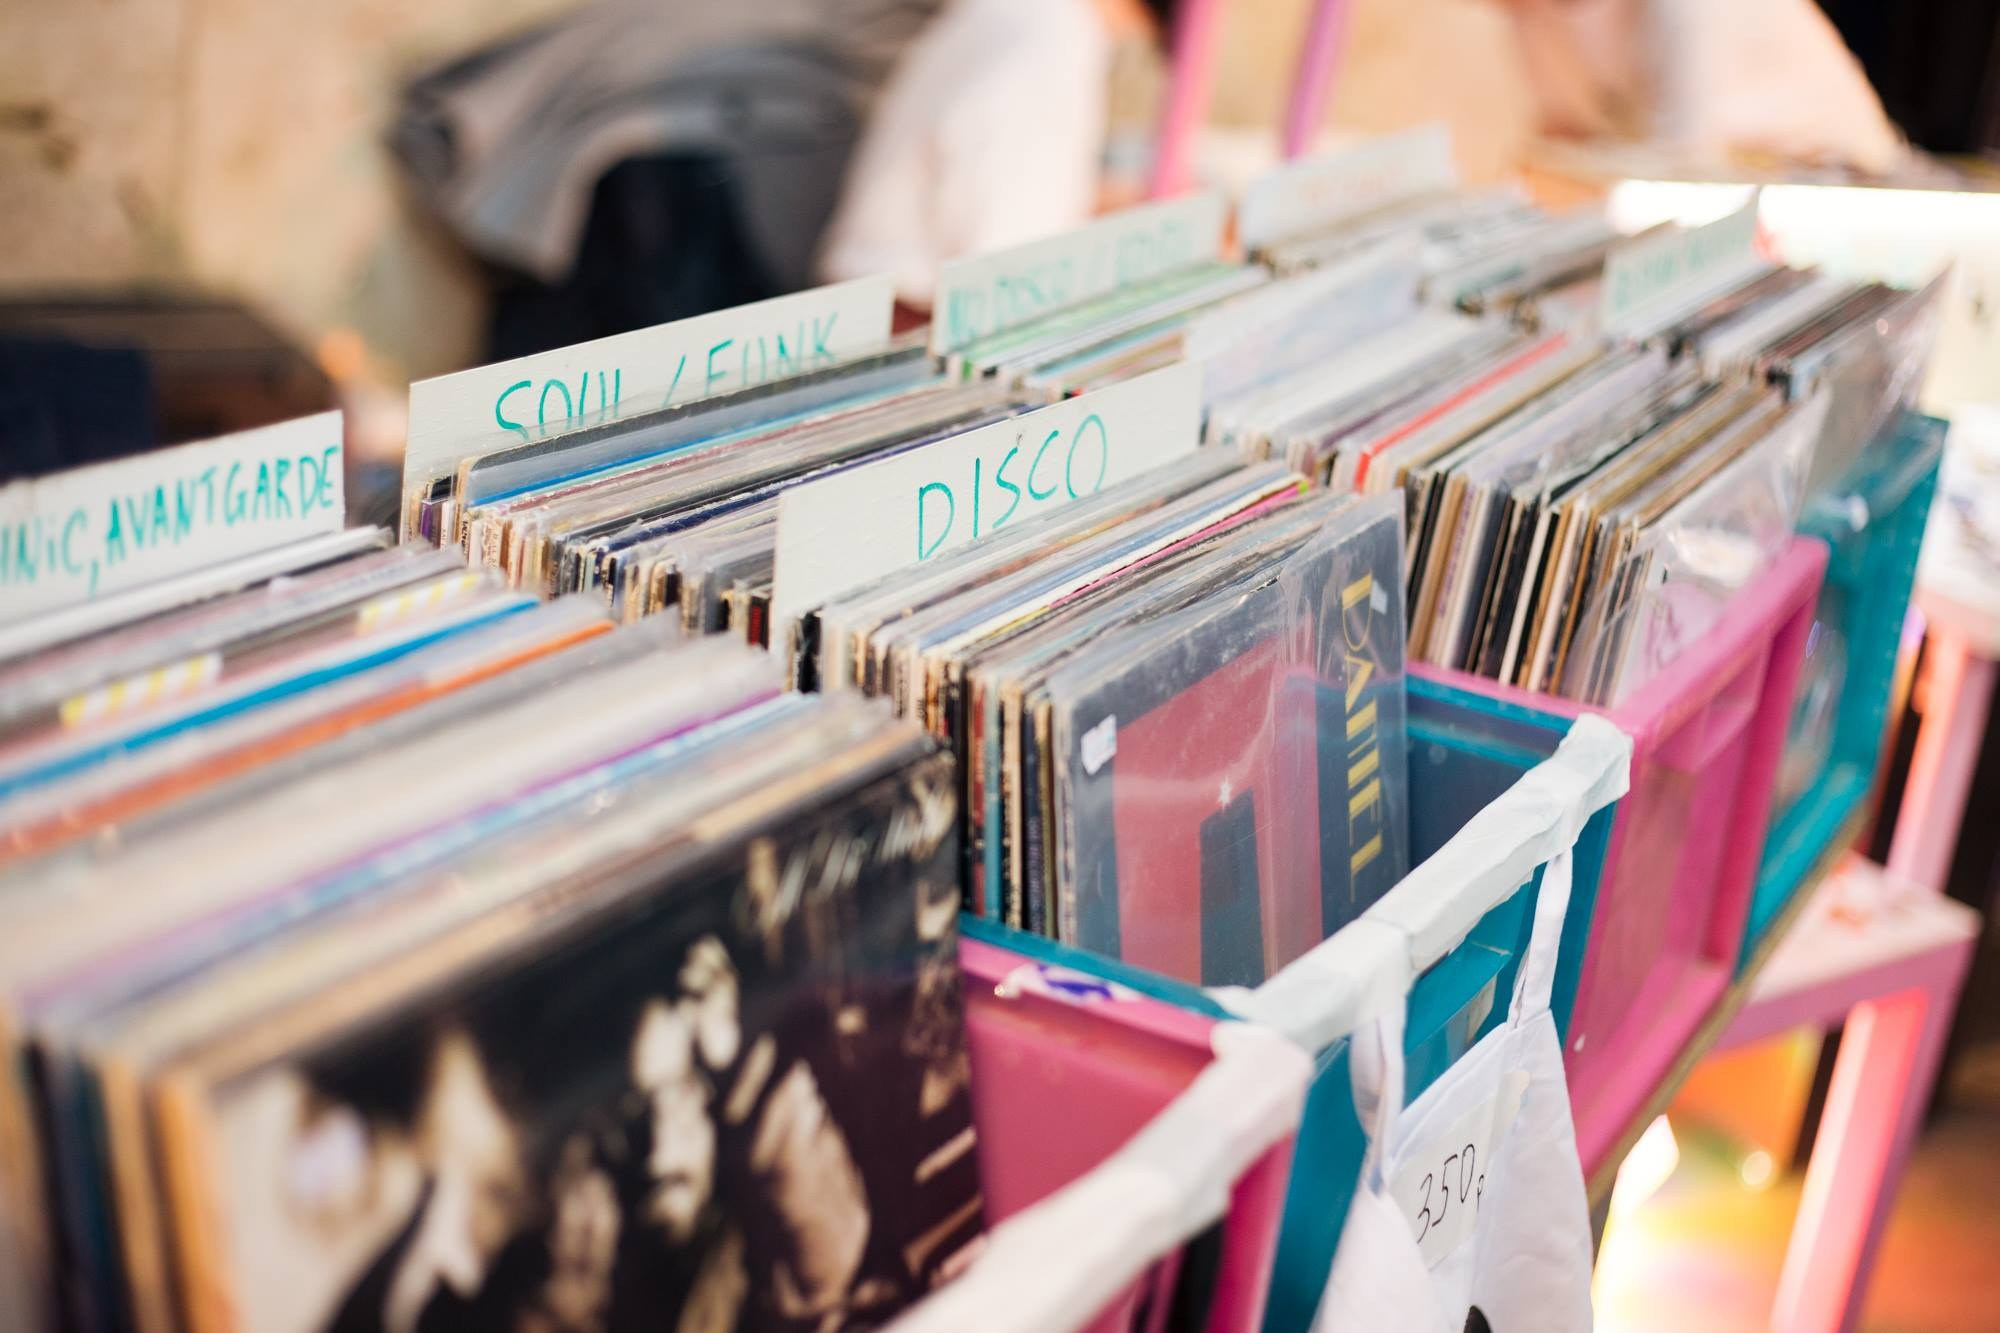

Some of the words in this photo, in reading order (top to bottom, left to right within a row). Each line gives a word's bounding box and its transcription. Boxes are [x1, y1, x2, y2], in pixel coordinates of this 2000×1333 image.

[703, 311, 838, 398] FUNK
[918, 413, 1108, 561] DISCO
[1341, 568, 1384, 905] DANIEL
